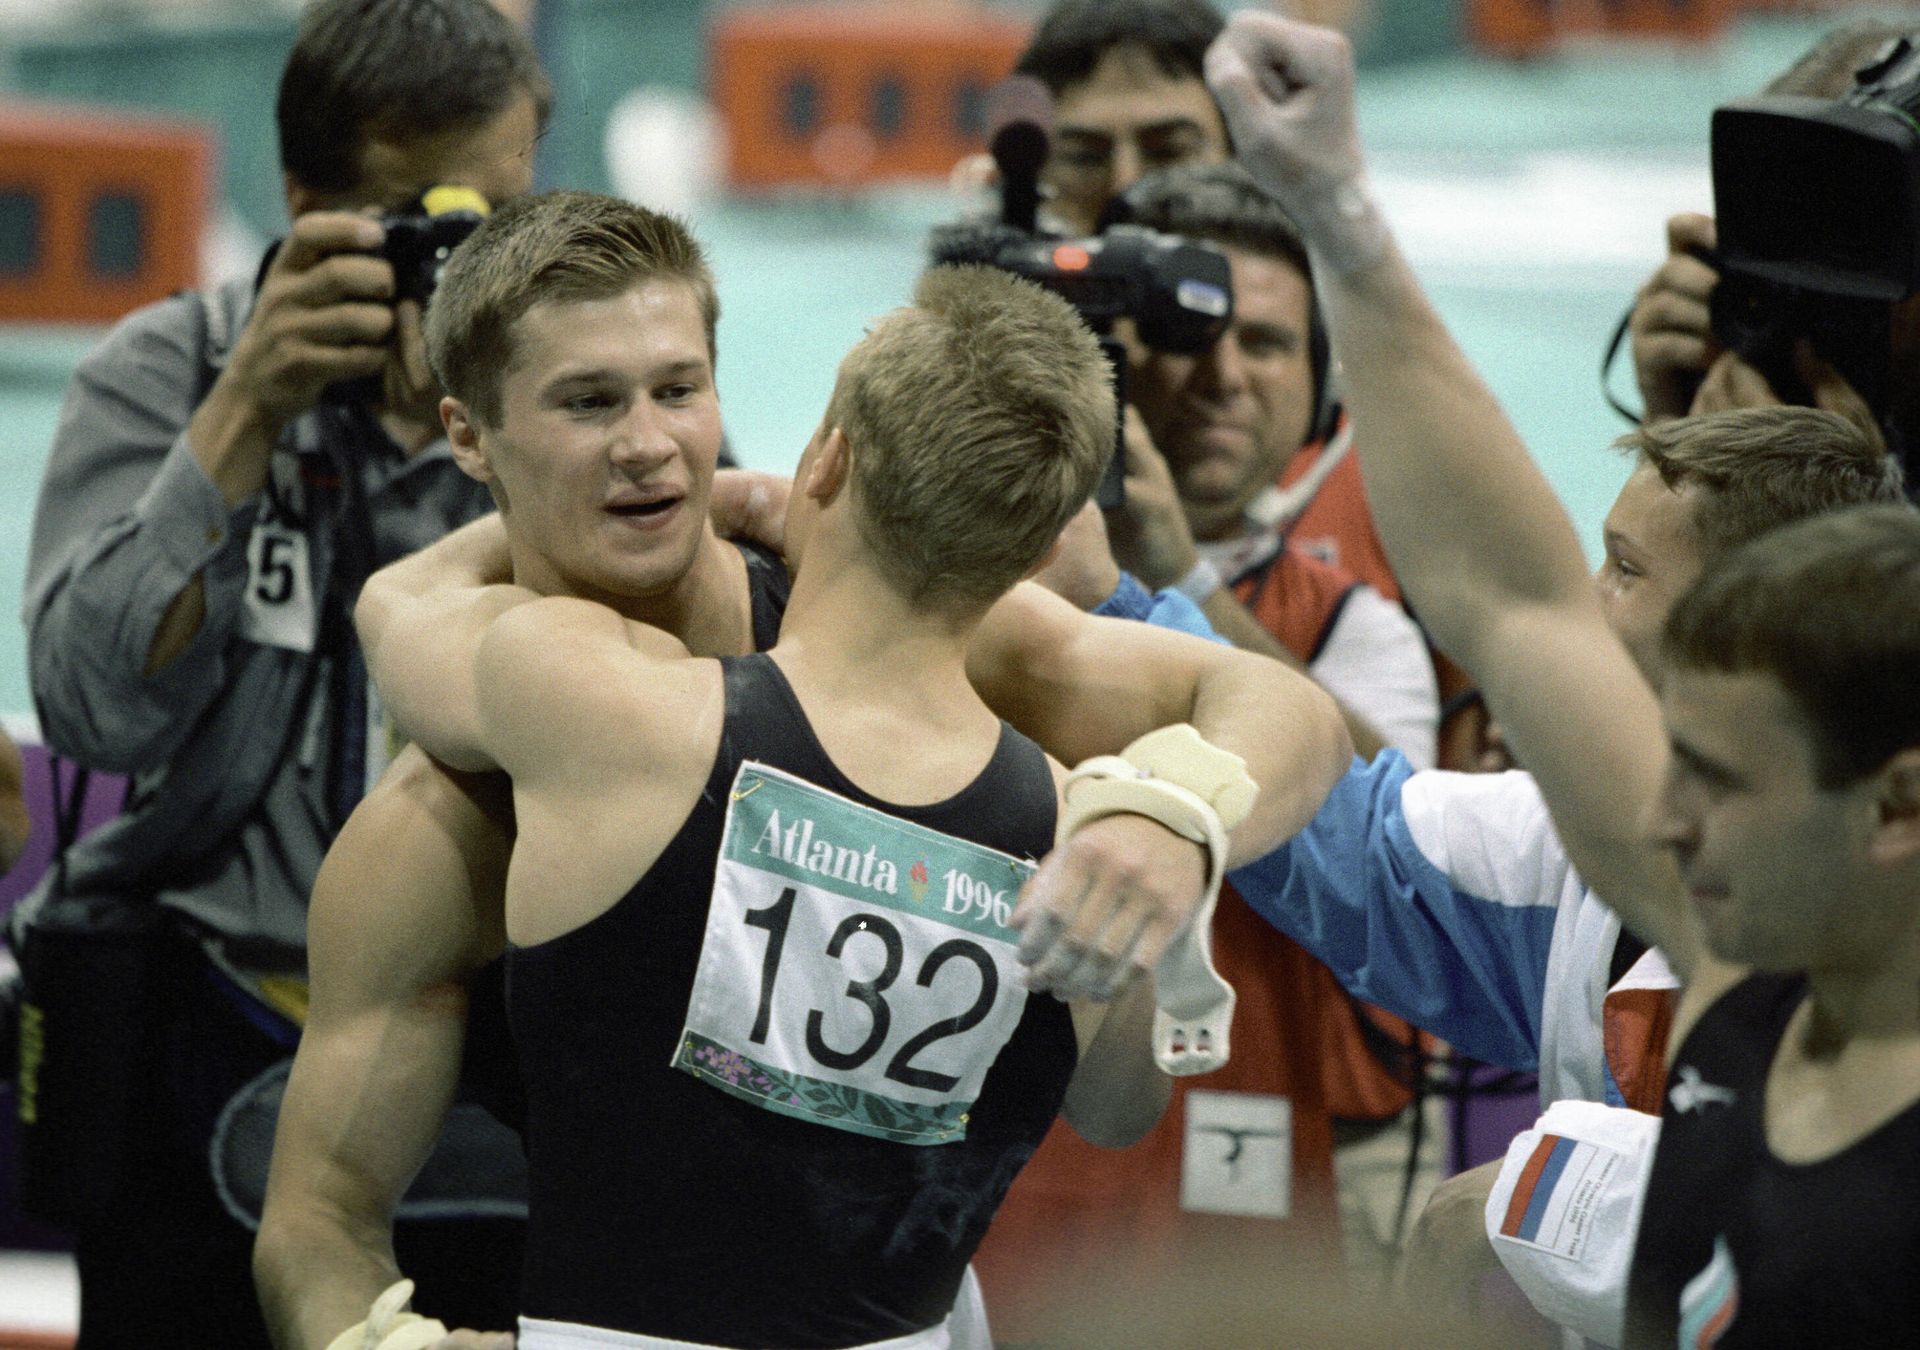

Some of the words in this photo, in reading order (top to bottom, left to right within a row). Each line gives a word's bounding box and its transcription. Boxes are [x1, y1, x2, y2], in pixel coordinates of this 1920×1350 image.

[257, 536, 294, 605] 5
[749, 808, 898, 895] Atlanta
[941, 868, 1013, 929] 1996
[743, 886, 999, 1094] 132
